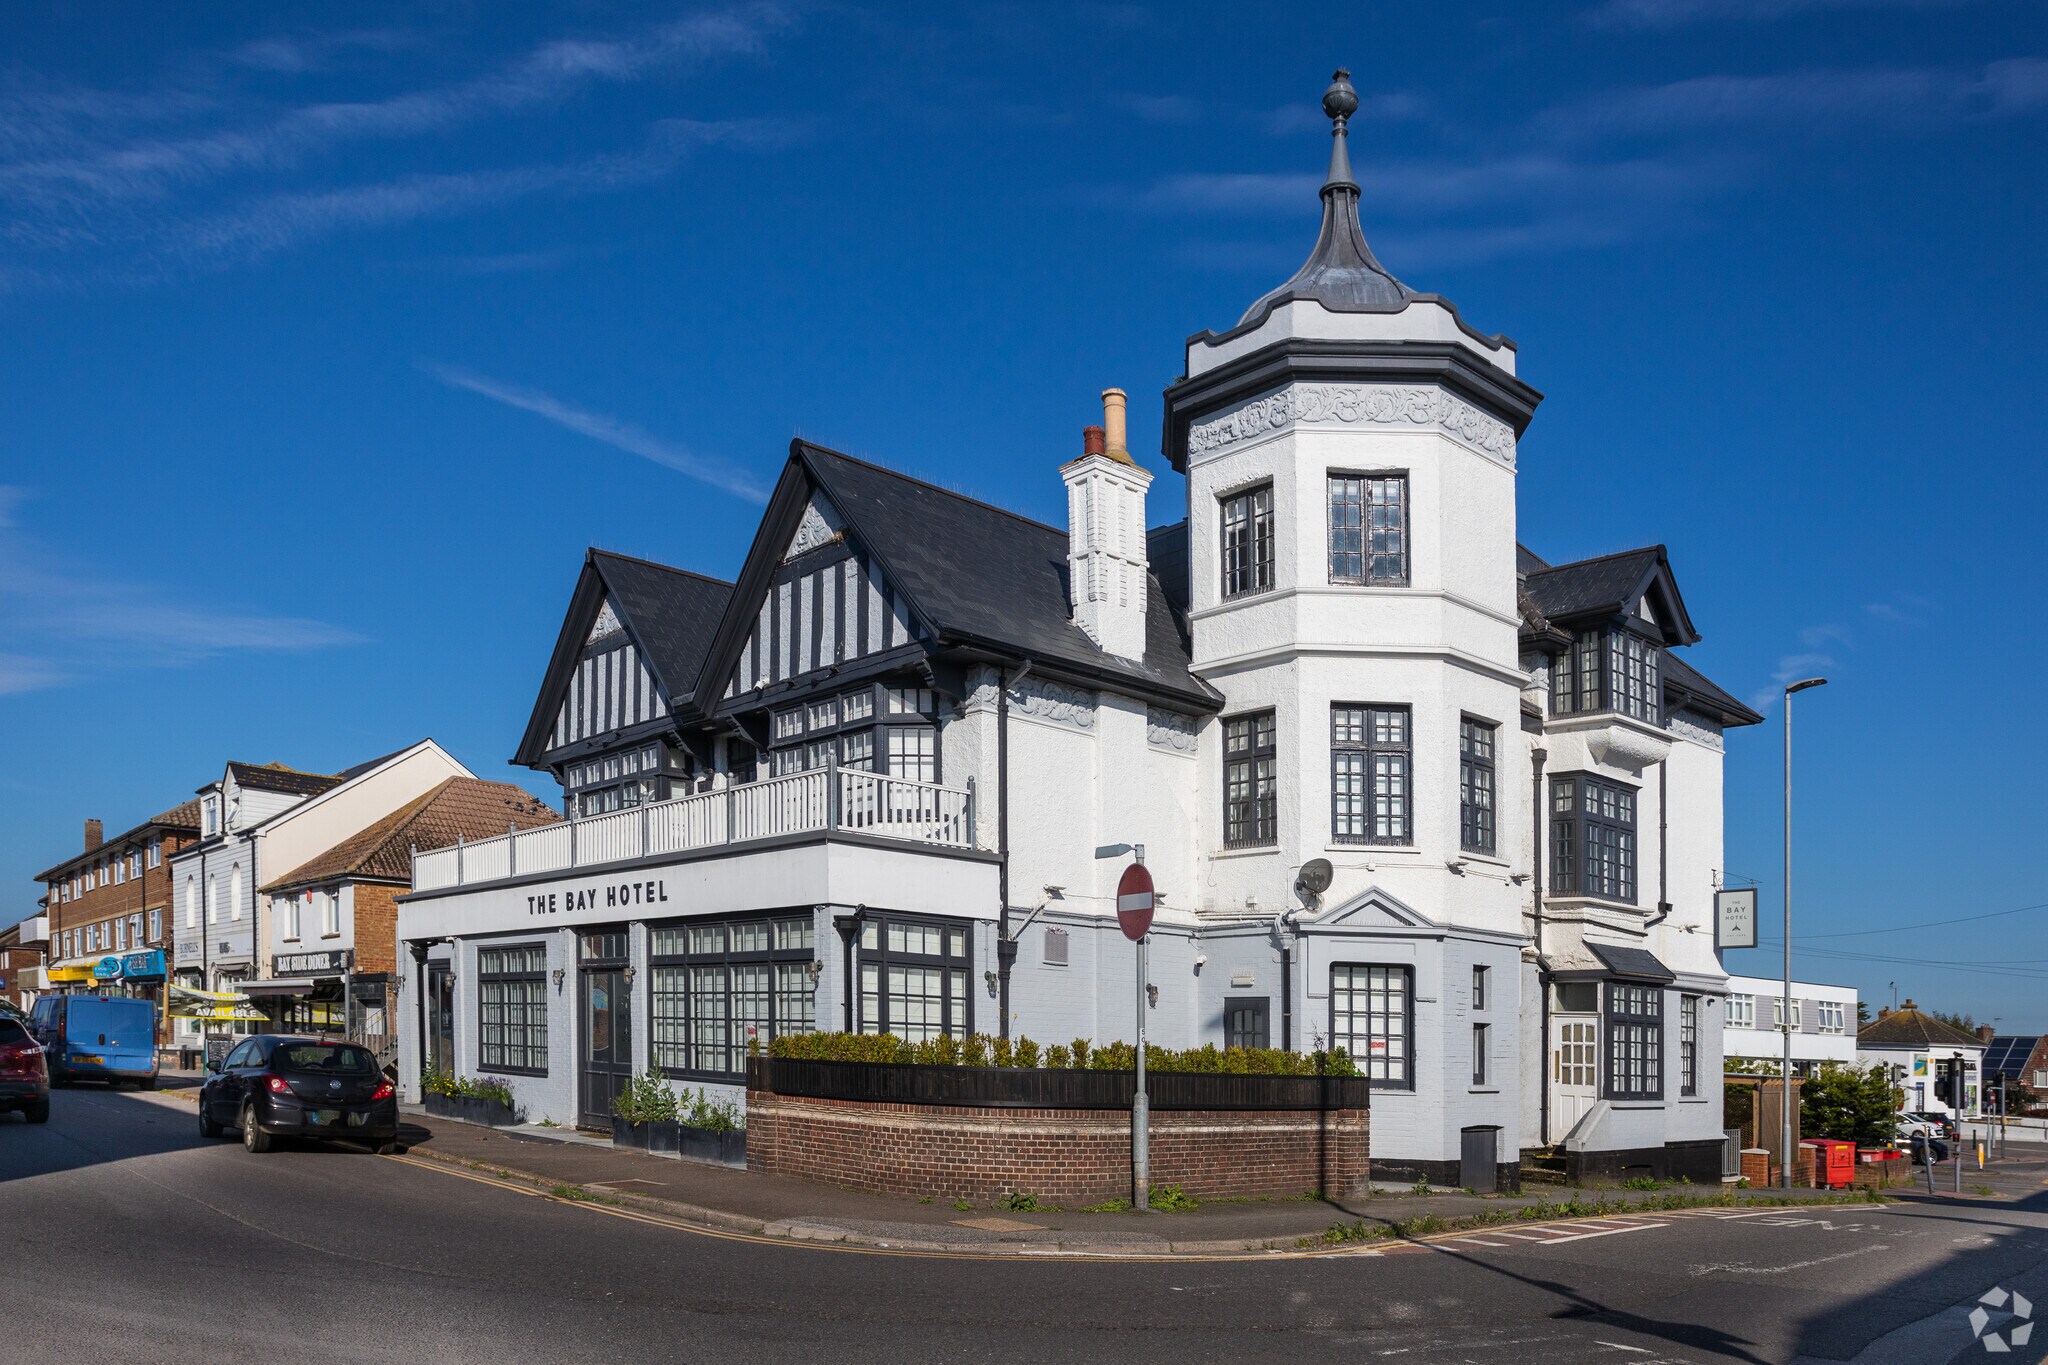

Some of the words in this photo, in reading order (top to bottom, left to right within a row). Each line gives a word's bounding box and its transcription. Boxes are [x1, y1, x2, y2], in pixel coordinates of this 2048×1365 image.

[527, 894, 556, 915] THE
[566, 888, 597, 912] BAY
[606, 880, 668, 907] HOTEL
[278, 956, 290, 971] BAY
[291, 955, 307, 971] SIDE
[308, 954, 330, 970] DINER
[196, 1008, 256, 1017] AVAILABLE
